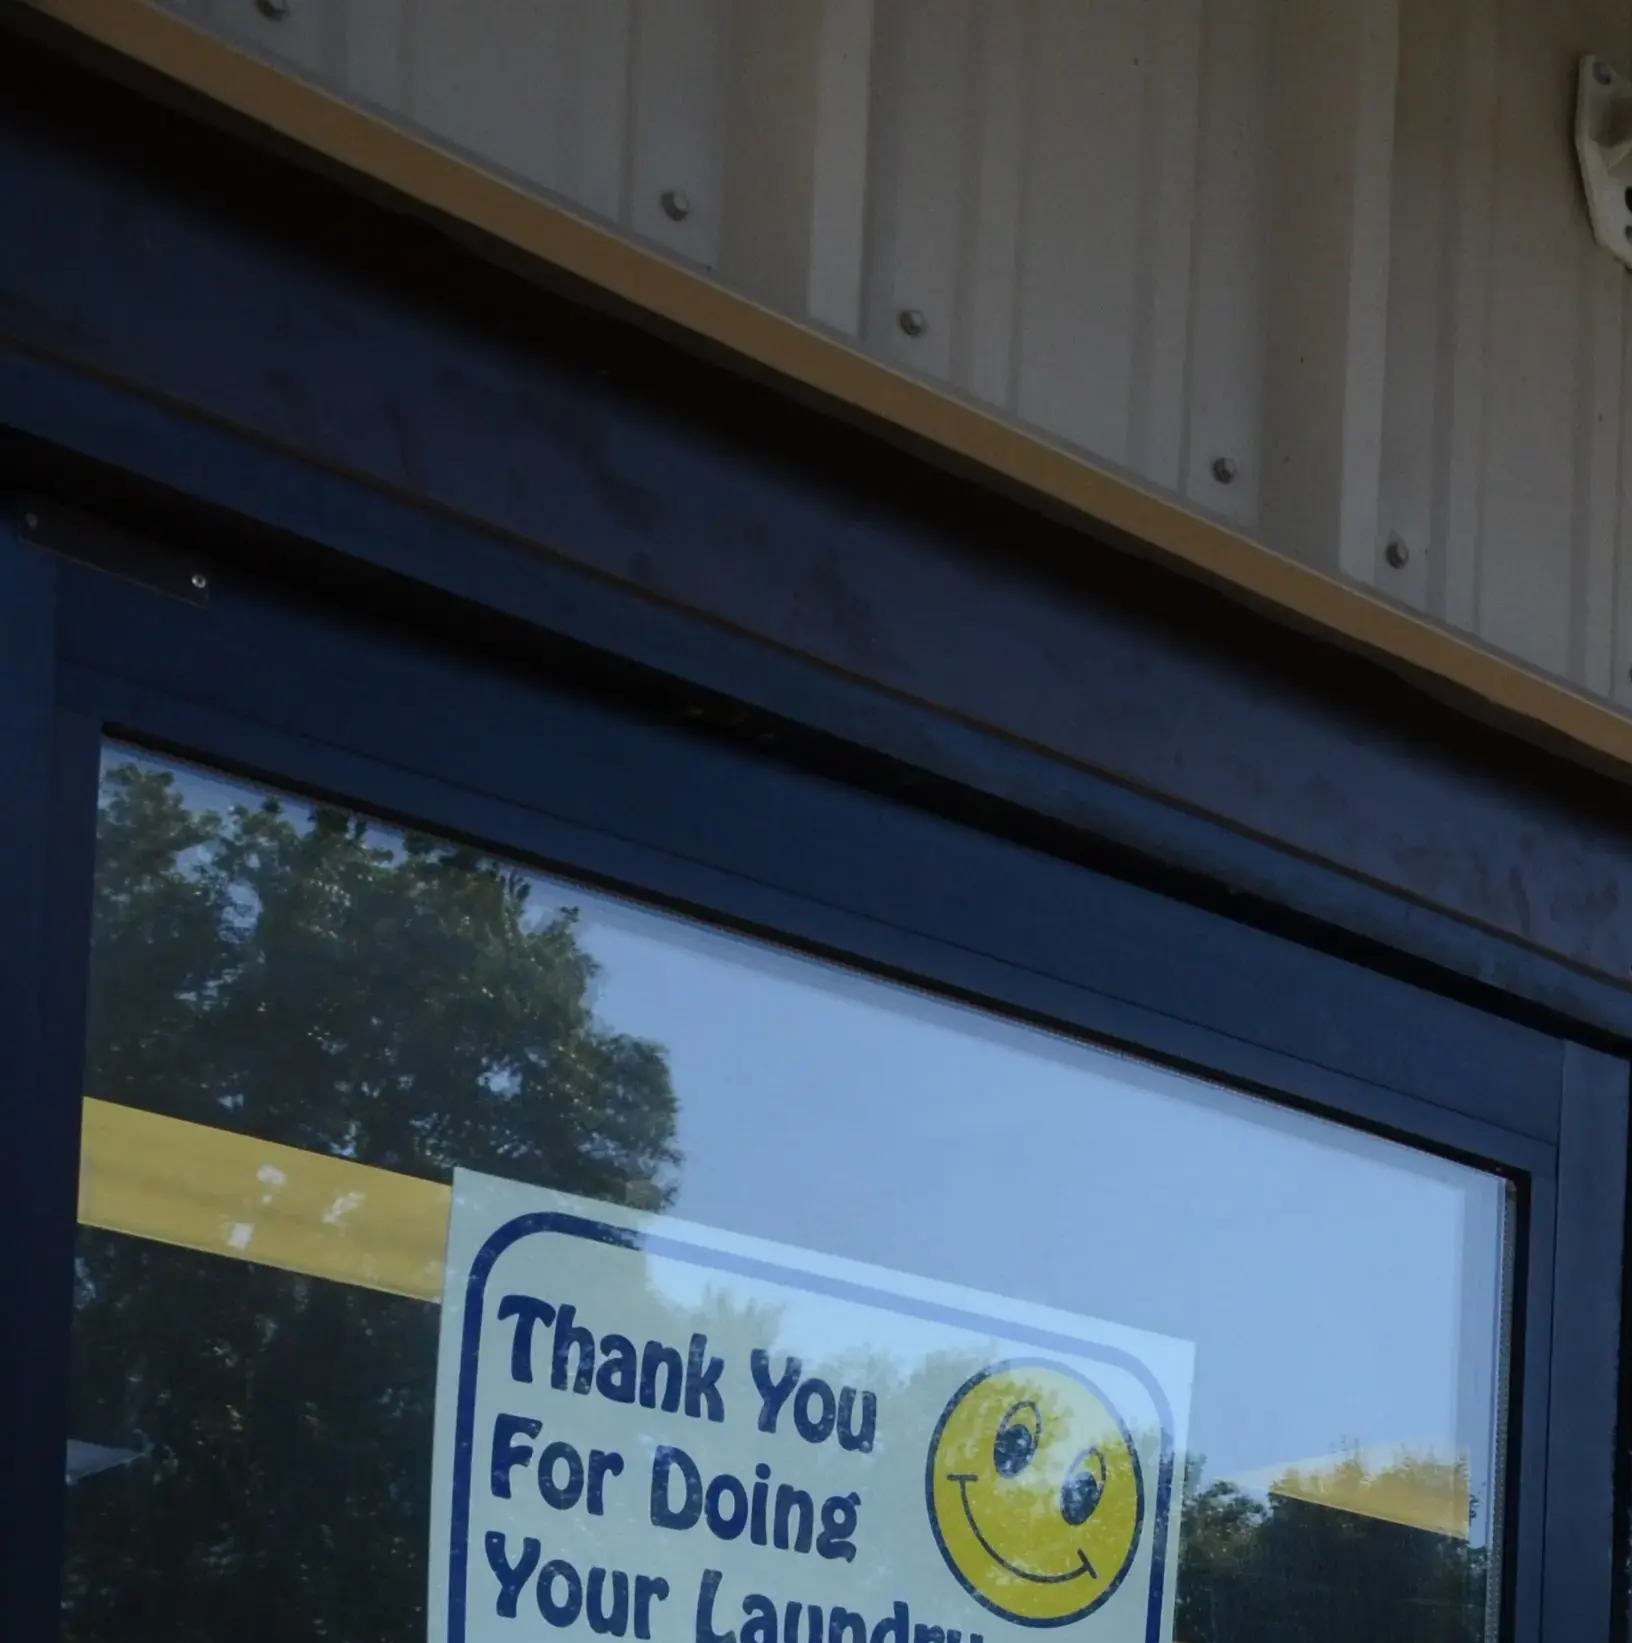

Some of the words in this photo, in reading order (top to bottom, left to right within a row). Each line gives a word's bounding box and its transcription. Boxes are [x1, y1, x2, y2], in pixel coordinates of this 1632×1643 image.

[498, 1294, 725, 1423] Thank
[750, 1348, 878, 1454] You
[490, 1413, 624, 1516] For
[650, 1445, 861, 1563] Doing
[485, 1531, 669, 1639] Your
